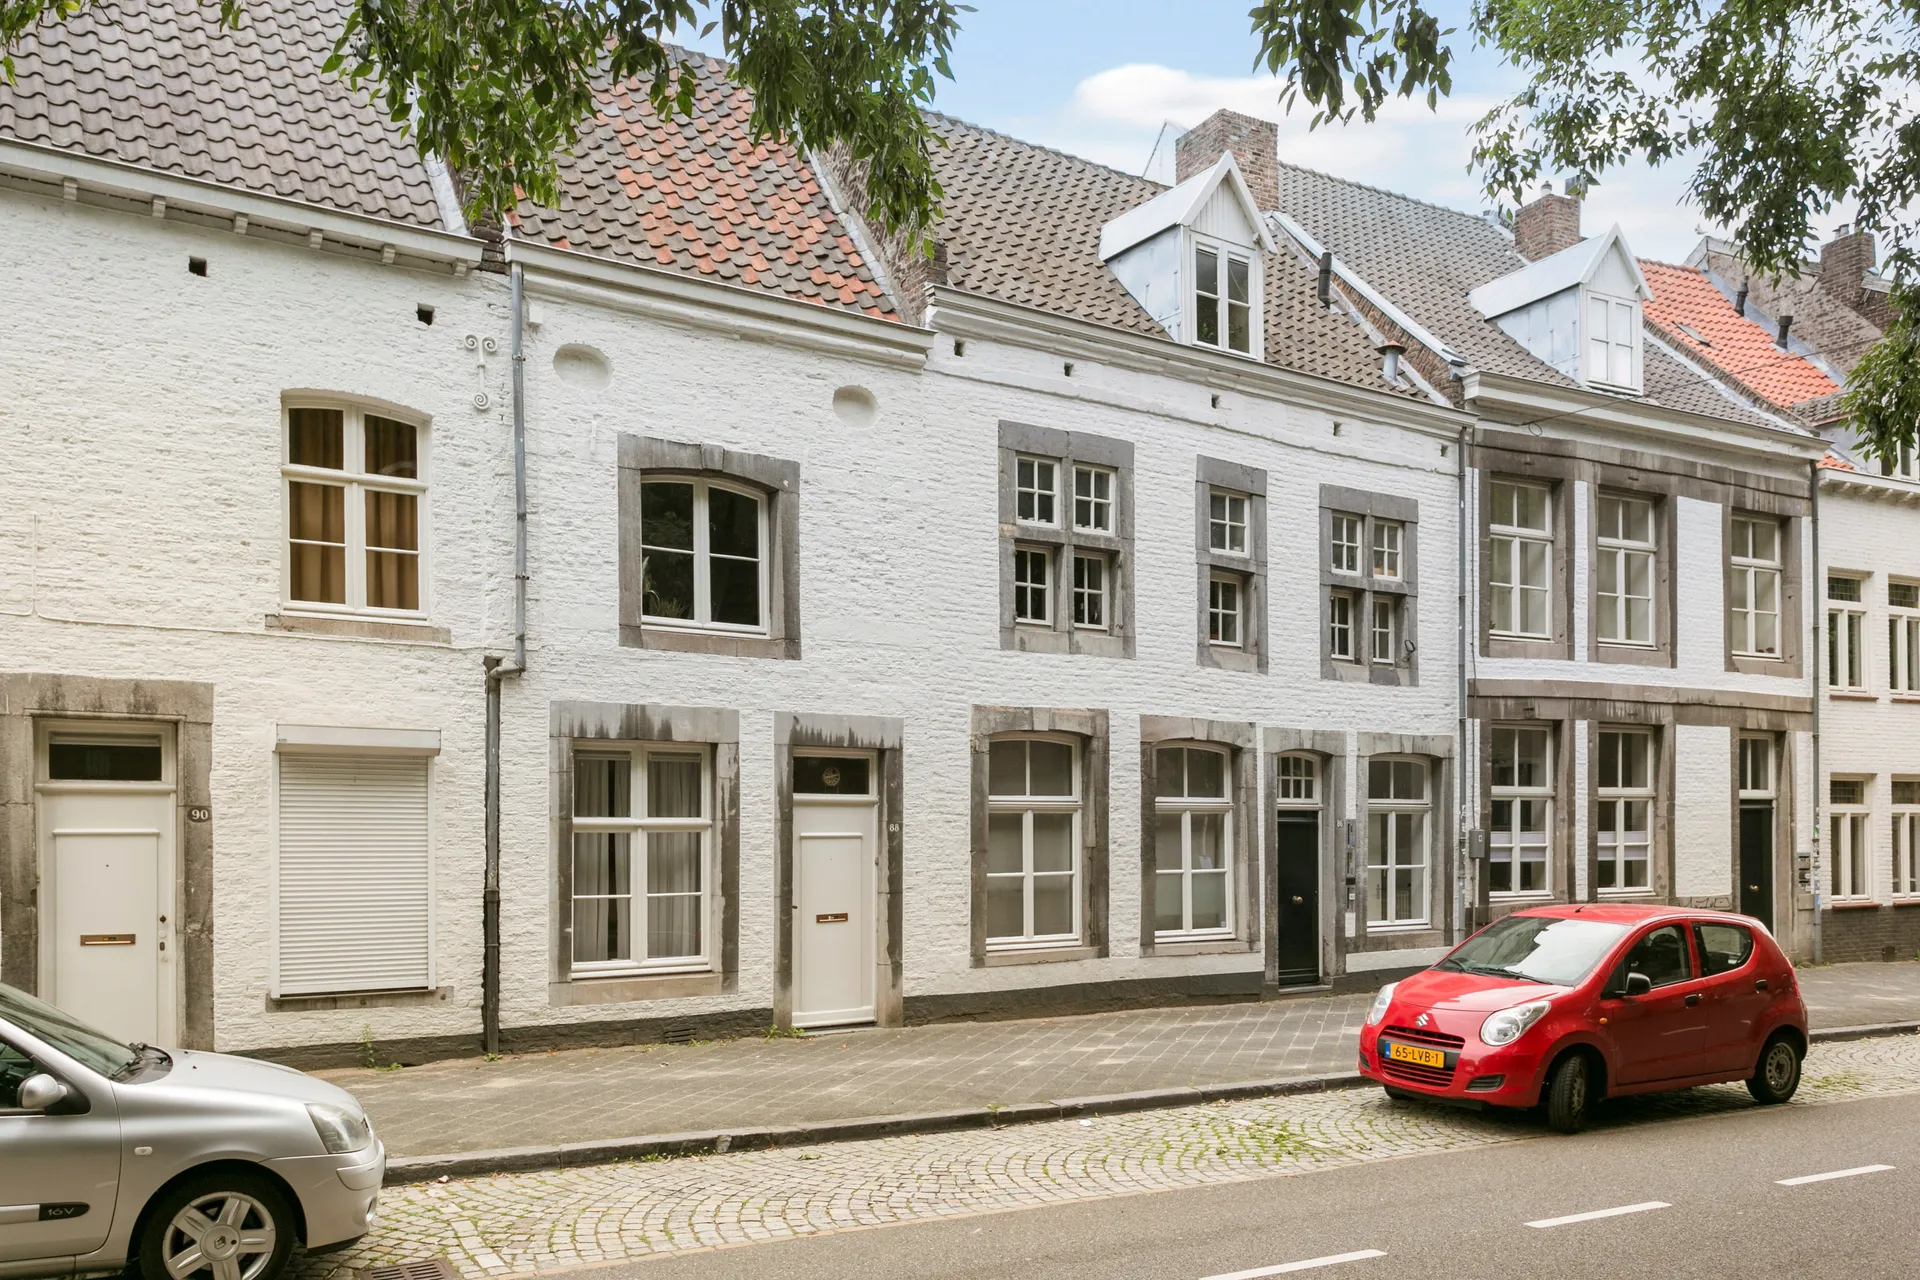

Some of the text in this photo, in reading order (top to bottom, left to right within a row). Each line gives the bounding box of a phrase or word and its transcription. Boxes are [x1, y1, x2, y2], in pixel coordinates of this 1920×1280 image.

[192, 809, 208, 820] 90
[889, 823, 899, 832] 88
[1395, 1046, 1439, 1064] 65-LVB-1
[48, 1207, 75, 1216] 16V
